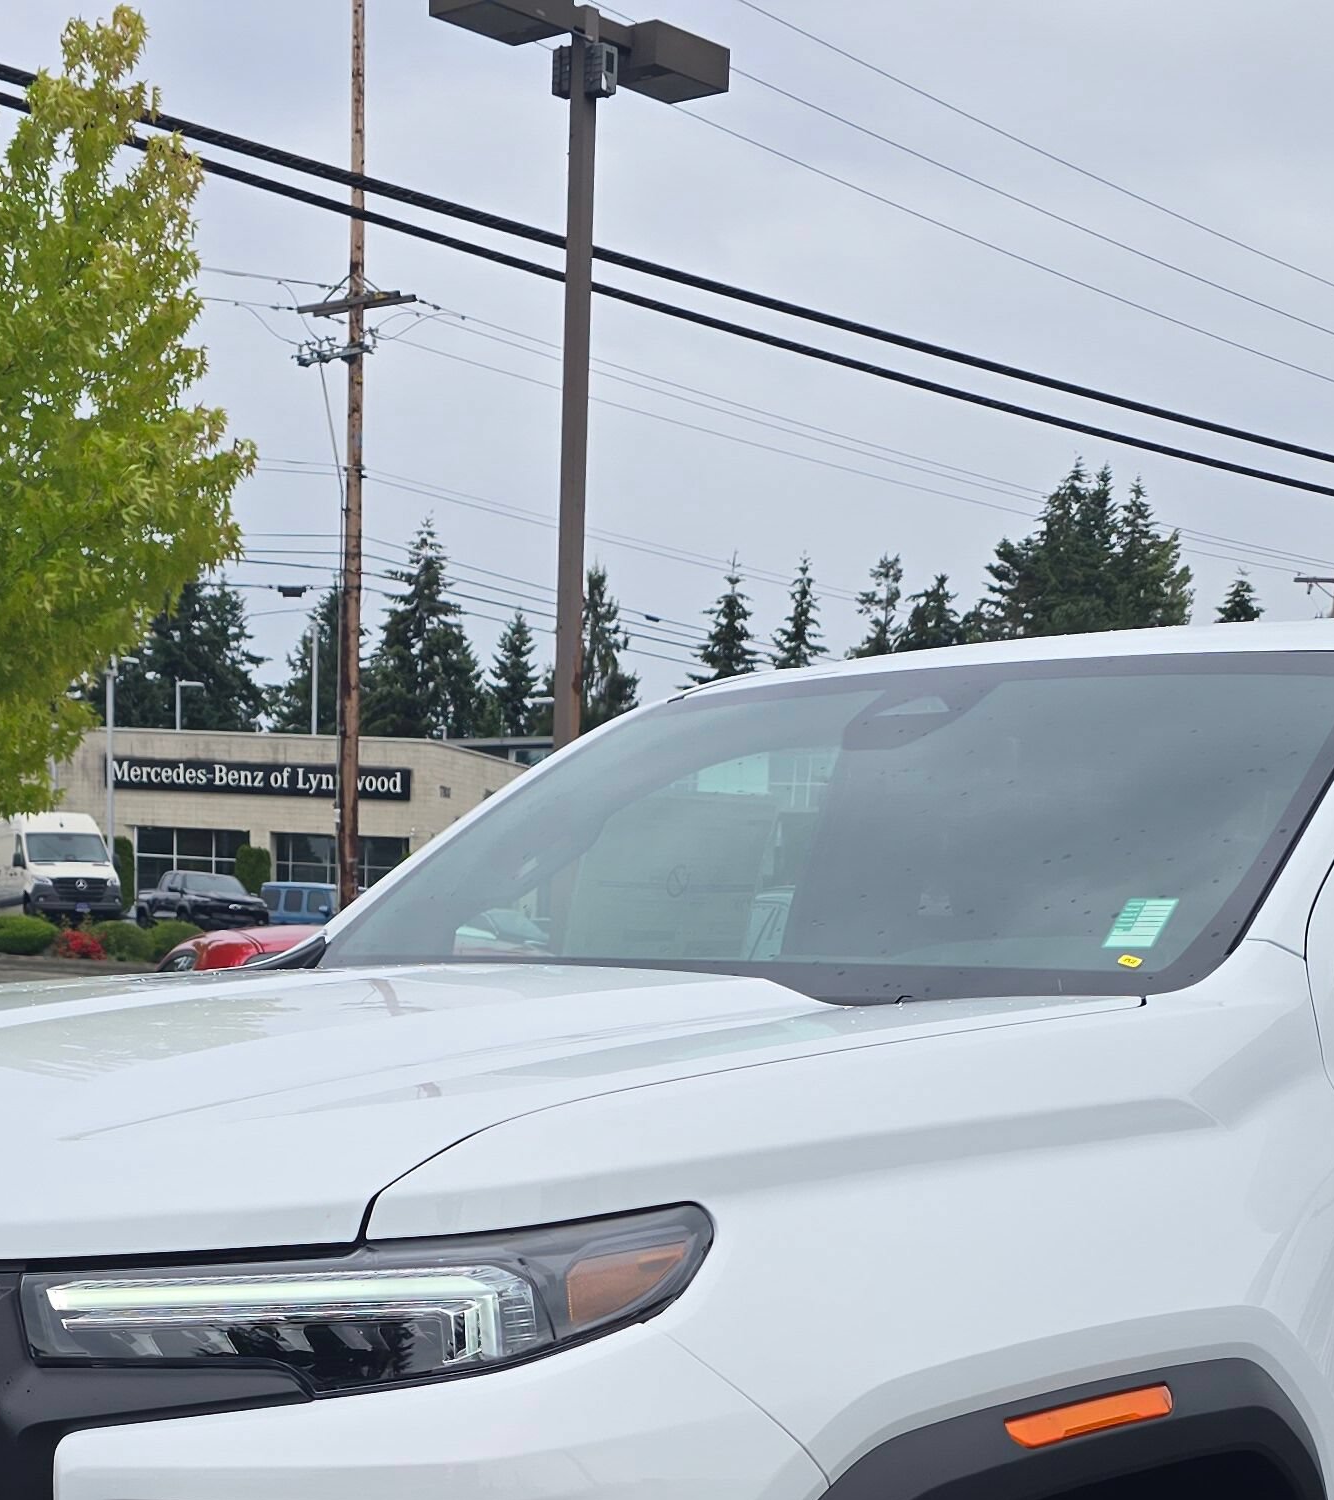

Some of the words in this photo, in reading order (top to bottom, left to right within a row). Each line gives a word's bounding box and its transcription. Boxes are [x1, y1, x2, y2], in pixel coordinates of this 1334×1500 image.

[111, 761, 264, 788] Mercedes-Benz
[270, 768, 292, 788] of
[296, 768, 402, 794] Lynood
